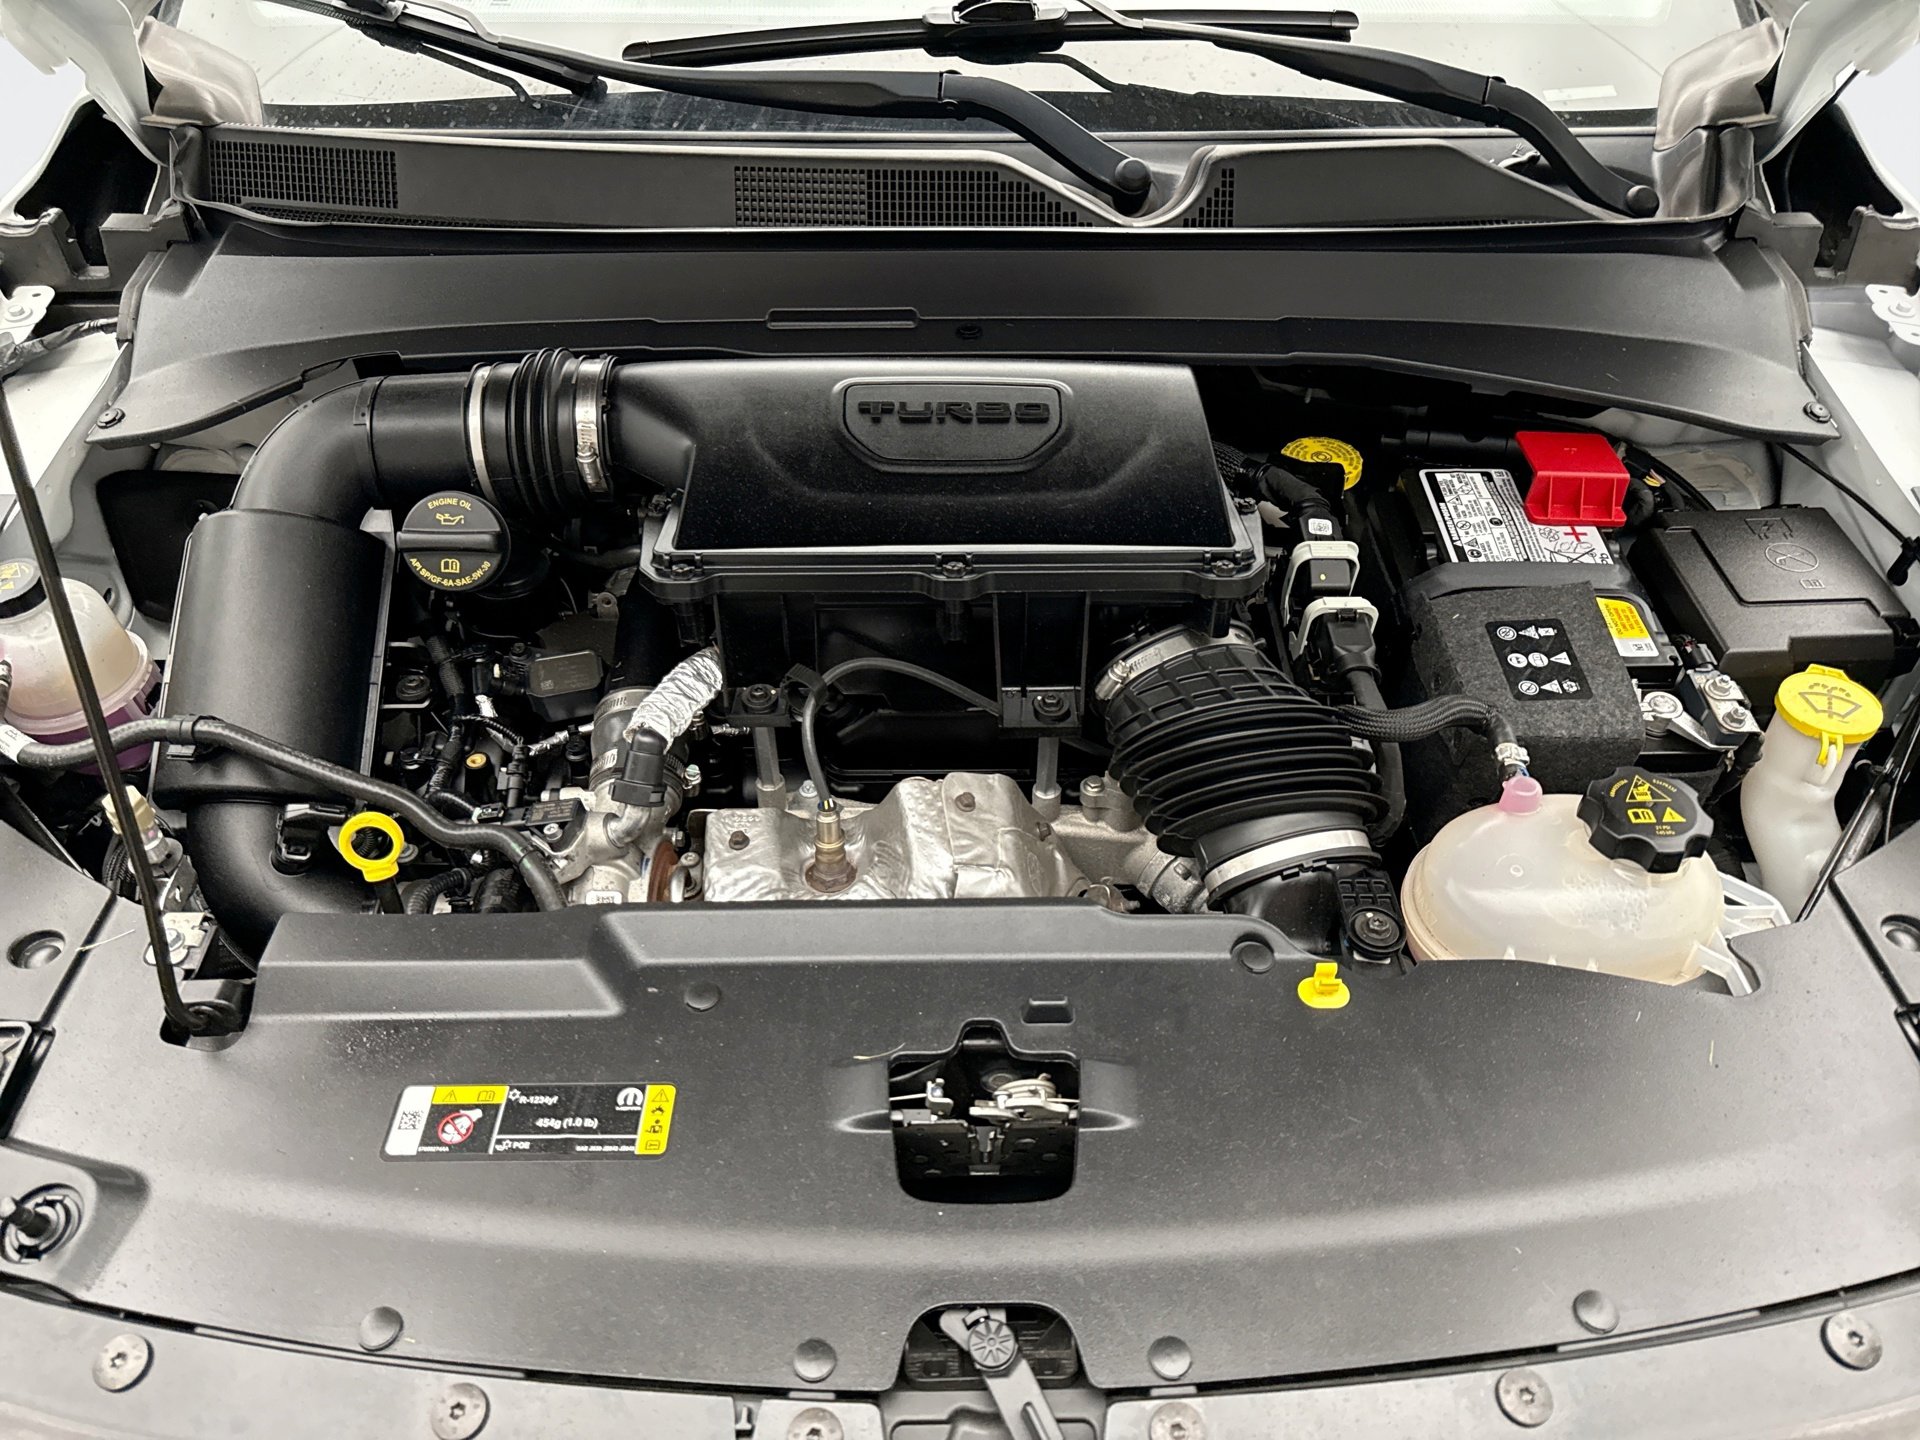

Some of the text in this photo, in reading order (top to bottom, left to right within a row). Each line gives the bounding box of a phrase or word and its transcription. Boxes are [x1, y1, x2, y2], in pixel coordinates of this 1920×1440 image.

[858, 400, 1050, 424] TURBO
[427, 497, 472, 511] ENGINE OIL
[410, 557, 422, 571] API
[519, 1095, 559, 1105] R-1234yf
[536, 1117, 599, 1129] 454g (1.0 lb)
[513, 1141, 531, 1149] POE
